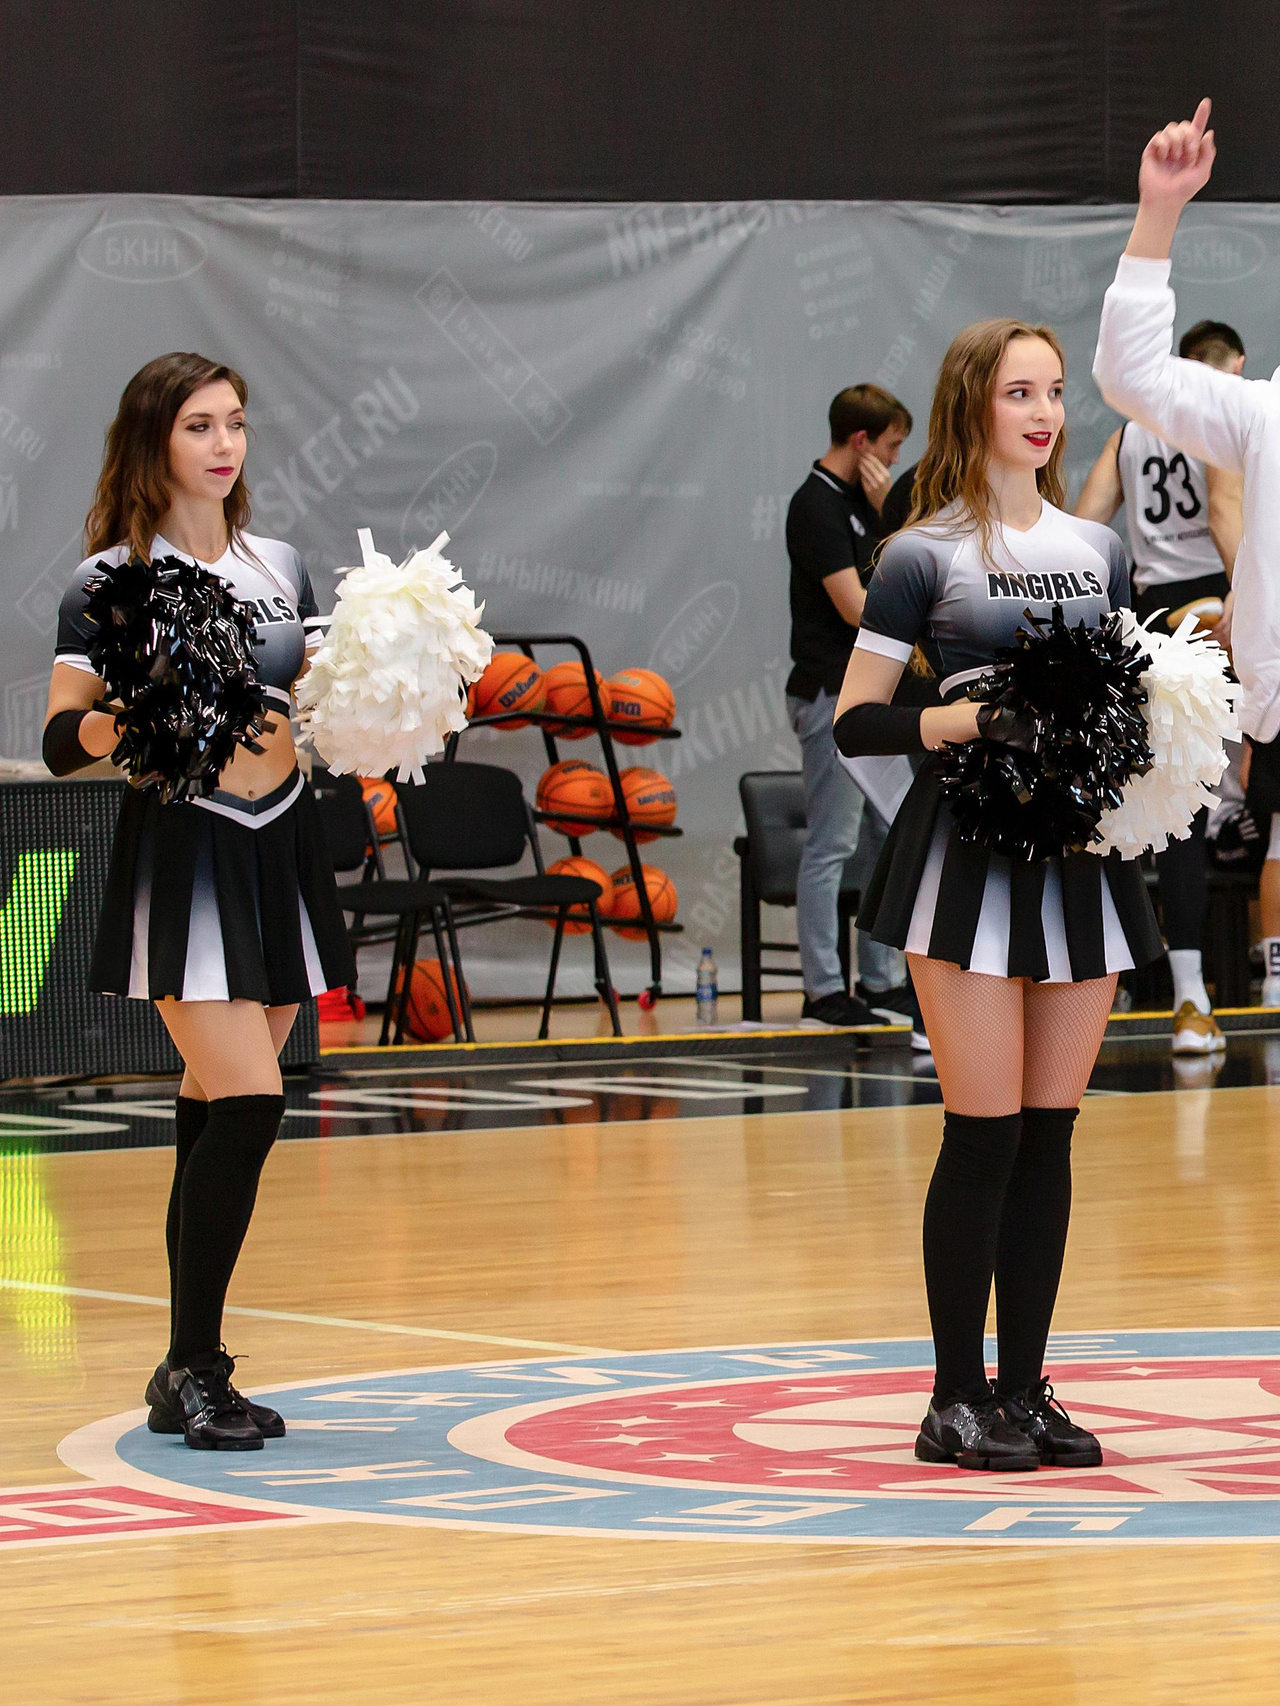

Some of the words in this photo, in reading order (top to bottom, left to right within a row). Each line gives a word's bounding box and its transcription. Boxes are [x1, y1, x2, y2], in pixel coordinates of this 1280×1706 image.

[104, 236, 181, 267] БКНН
[1142, 452, 1202, 525] 33
[986, 569, 1104, 603] NNGIRLS
